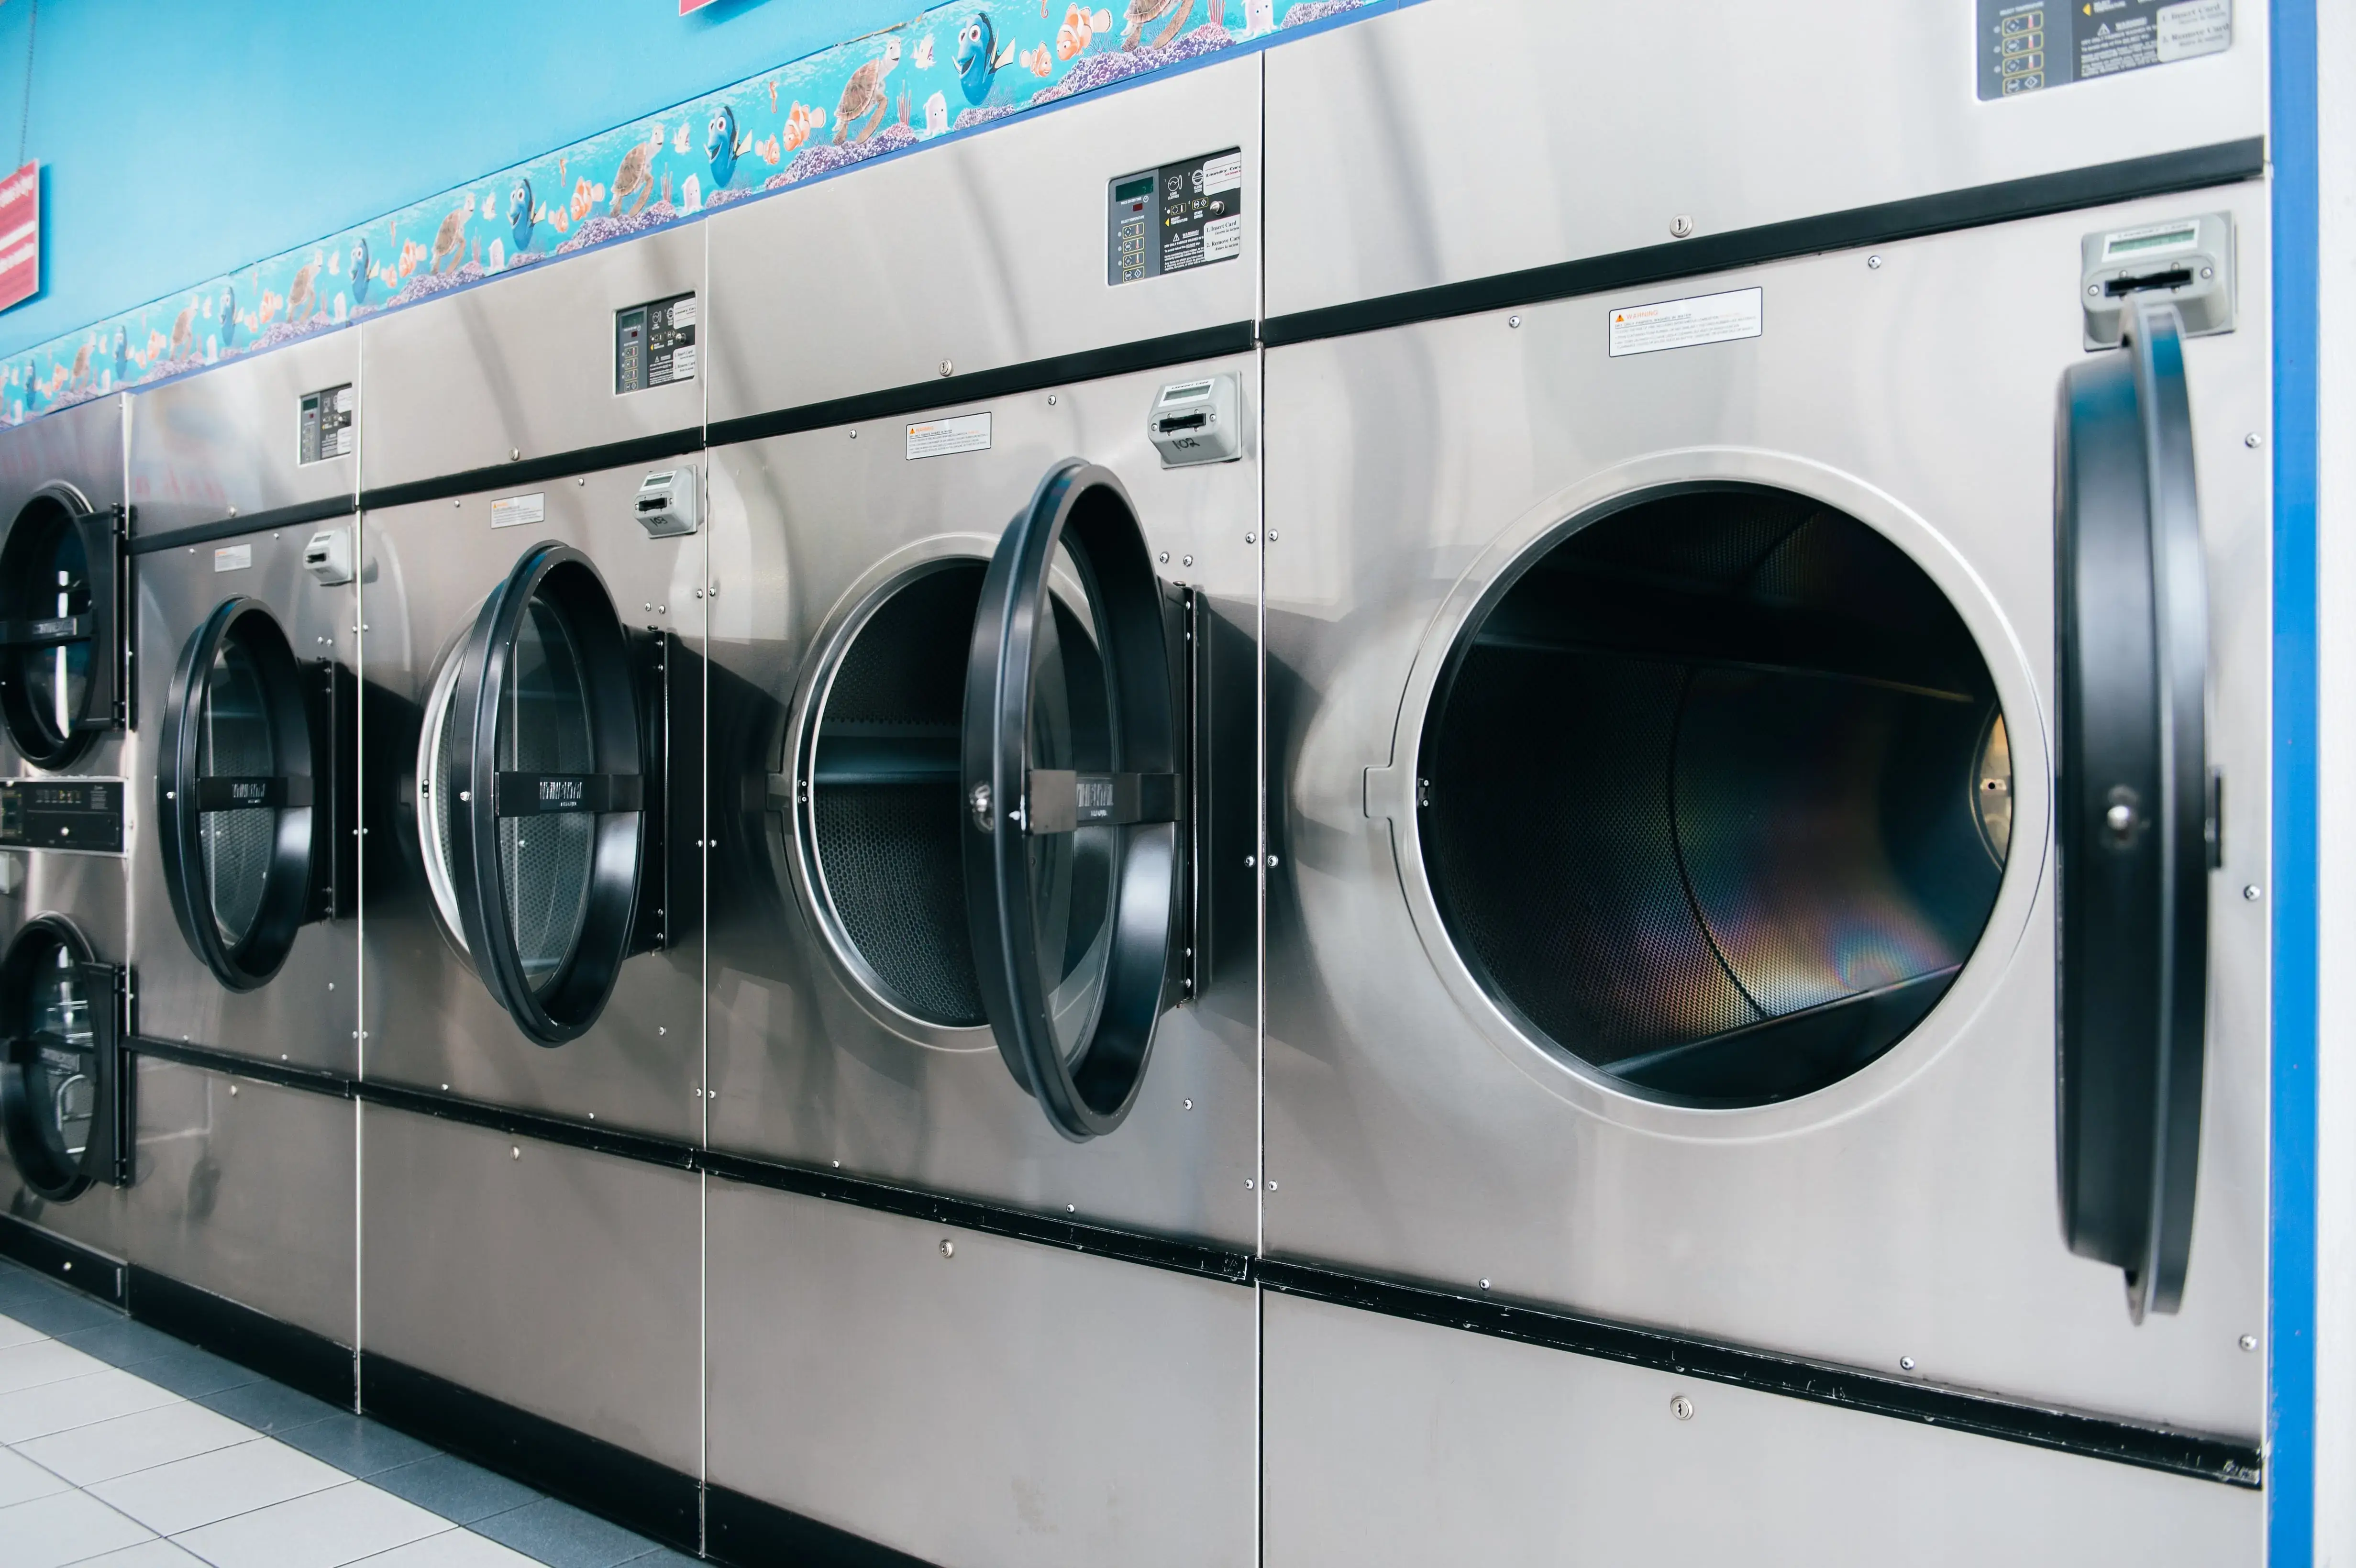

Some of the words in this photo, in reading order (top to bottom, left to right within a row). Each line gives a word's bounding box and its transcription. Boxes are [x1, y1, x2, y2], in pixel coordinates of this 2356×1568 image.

[2198, 2, 2220, 14] Card
[2172, 30, 2205, 40] Remove
[1206, 169, 1227, 177] Laundry
[1626, 310, 1659, 320] WARNING
[1172, 438, 1200, 452] 102
